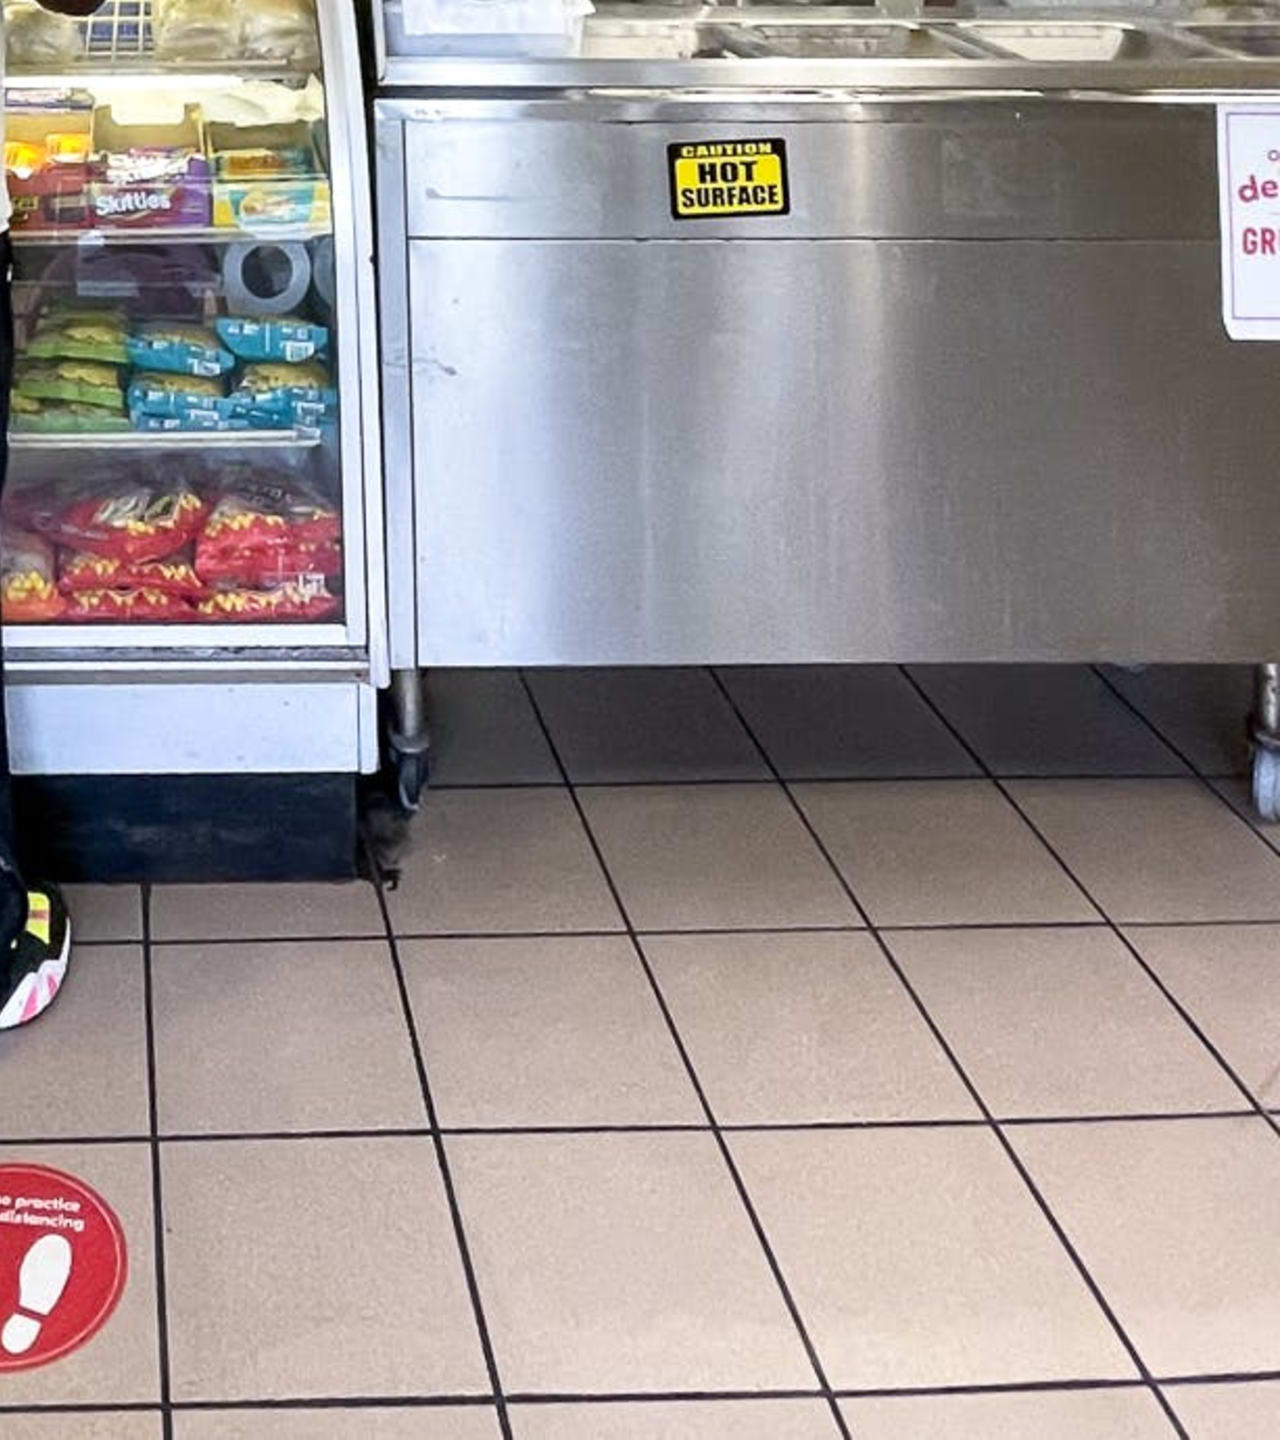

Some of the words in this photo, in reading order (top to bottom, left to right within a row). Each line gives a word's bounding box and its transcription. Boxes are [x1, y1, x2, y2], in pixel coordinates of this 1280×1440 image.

[681, 143, 772, 158] CAUTION
[698, 161, 758, 184] HOT
[94, 191, 172, 216] Skittles
[681, 184, 779, 208] SURFACE
[1242, 226, 1280, 256] GR
[15, 1196, 81, 1212] practice
